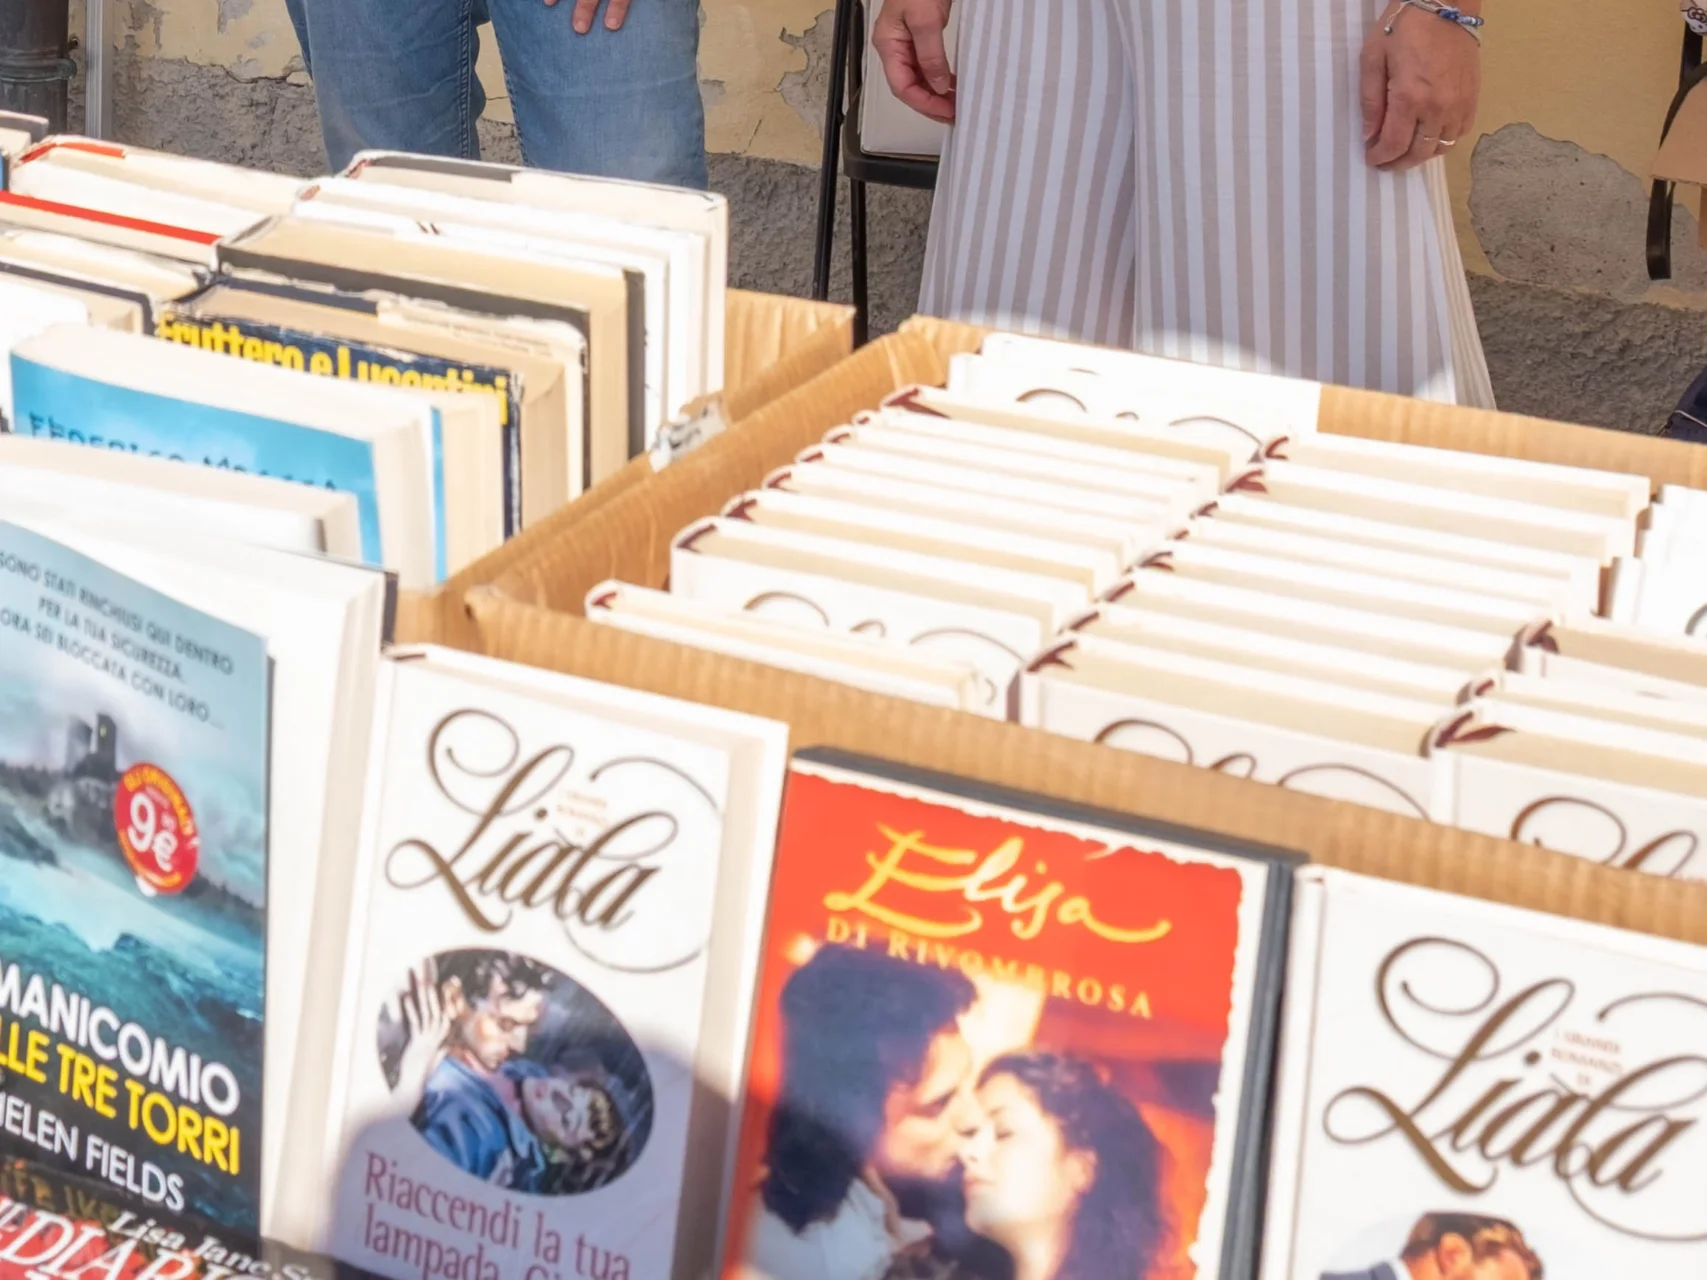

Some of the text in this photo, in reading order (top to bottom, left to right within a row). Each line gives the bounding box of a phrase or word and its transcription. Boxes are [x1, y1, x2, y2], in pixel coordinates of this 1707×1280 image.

[310, 351, 334, 376] e
[38, 596, 61, 620] PER
[64, 608, 79, 629] LA
[84, 616, 107, 643] TUA
[43, 568, 77, 599] STATI
[78, 586, 143, 633] RINCHIUSI
[145, 620, 172, 648] QUI
[174, 631, 235, 677] DENTRO
[57, 632, 128, 681] BLOCCATA
[130, 669, 164, 702] CON
[385, 708, 723, 973] Liala
[823, 823, 1172, 941] Elisa
[826, 916, 1153, 1020] DI RIVOMBROSA
[0, 958, 240, 1116] MANICOMIO
[1322, 936, 1707, 1243] Liala
[56, 1042, 119, 1119] TRE
[124, 1078, 240, 1176] TORRI
[85, 1134, 185, 1212] FIELDS
[364, 1151, 632, 1280] Riaccendi la tua
[106, 1210, 186, 1252] Lisa
